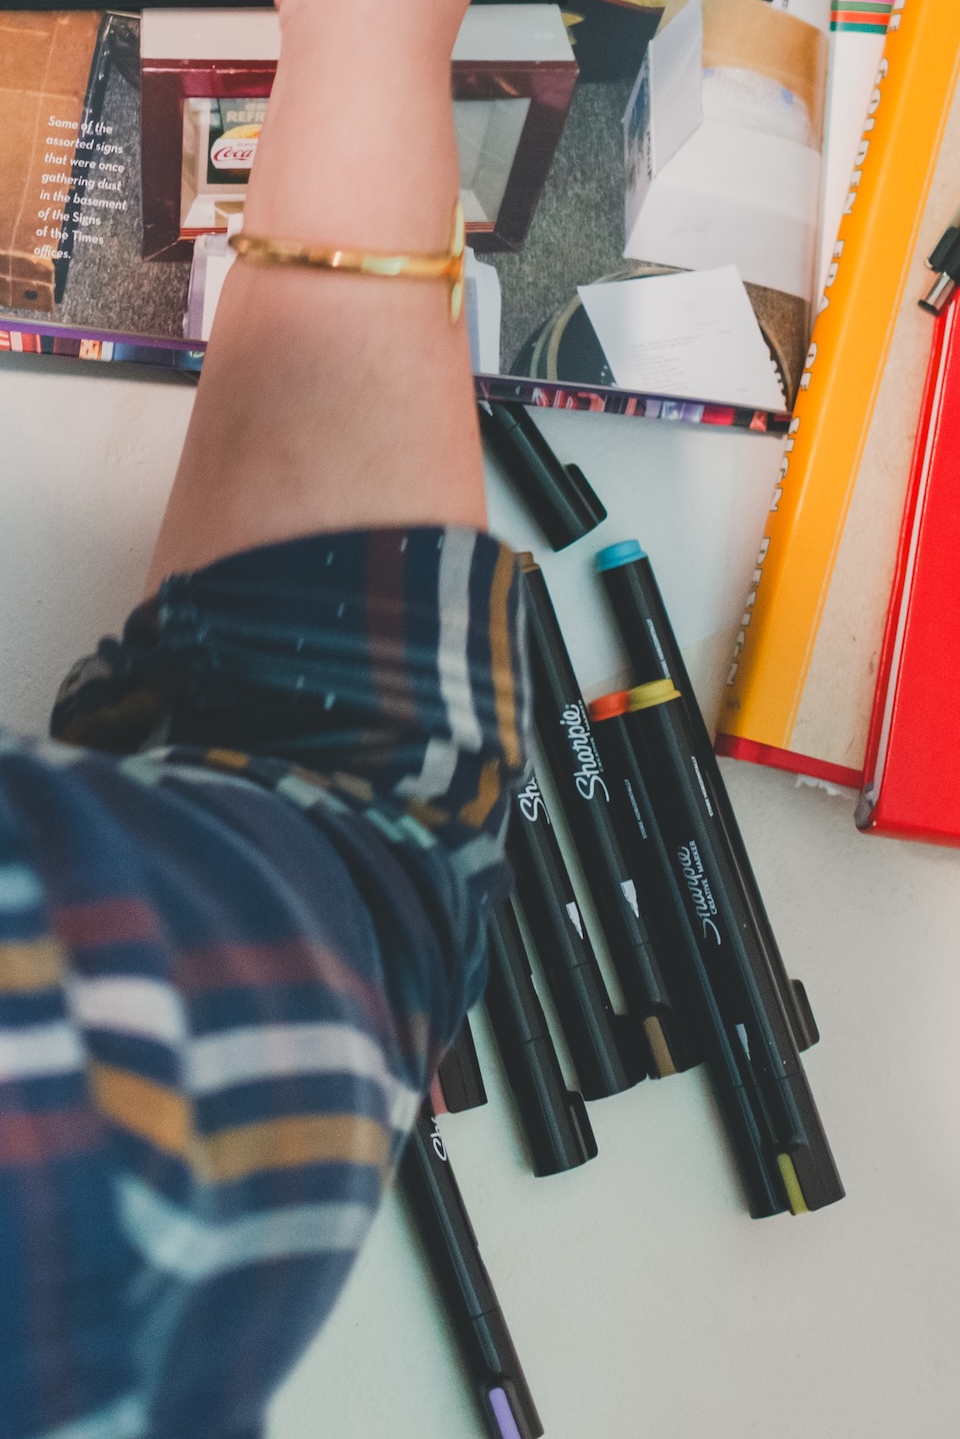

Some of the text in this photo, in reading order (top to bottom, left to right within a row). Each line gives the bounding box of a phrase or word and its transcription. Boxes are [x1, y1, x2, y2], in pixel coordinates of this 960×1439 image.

[48, 115, 113, 134] Some of the
[46, 136, 123, 155] assorted signs
[44, 152, 125, 173] that were once
[41, 173, 122, 191] gathering dust
[40, 189, 127, 210] in the basement
[37, 208, 101, 226] of the Signs
[35, 226, 104, 244] of the Times
[33, 245, 72, 259] offices.
[560, 703, 610, 802] Sharpie
[688, 840, 718, 915] CREATIVE MARKER
